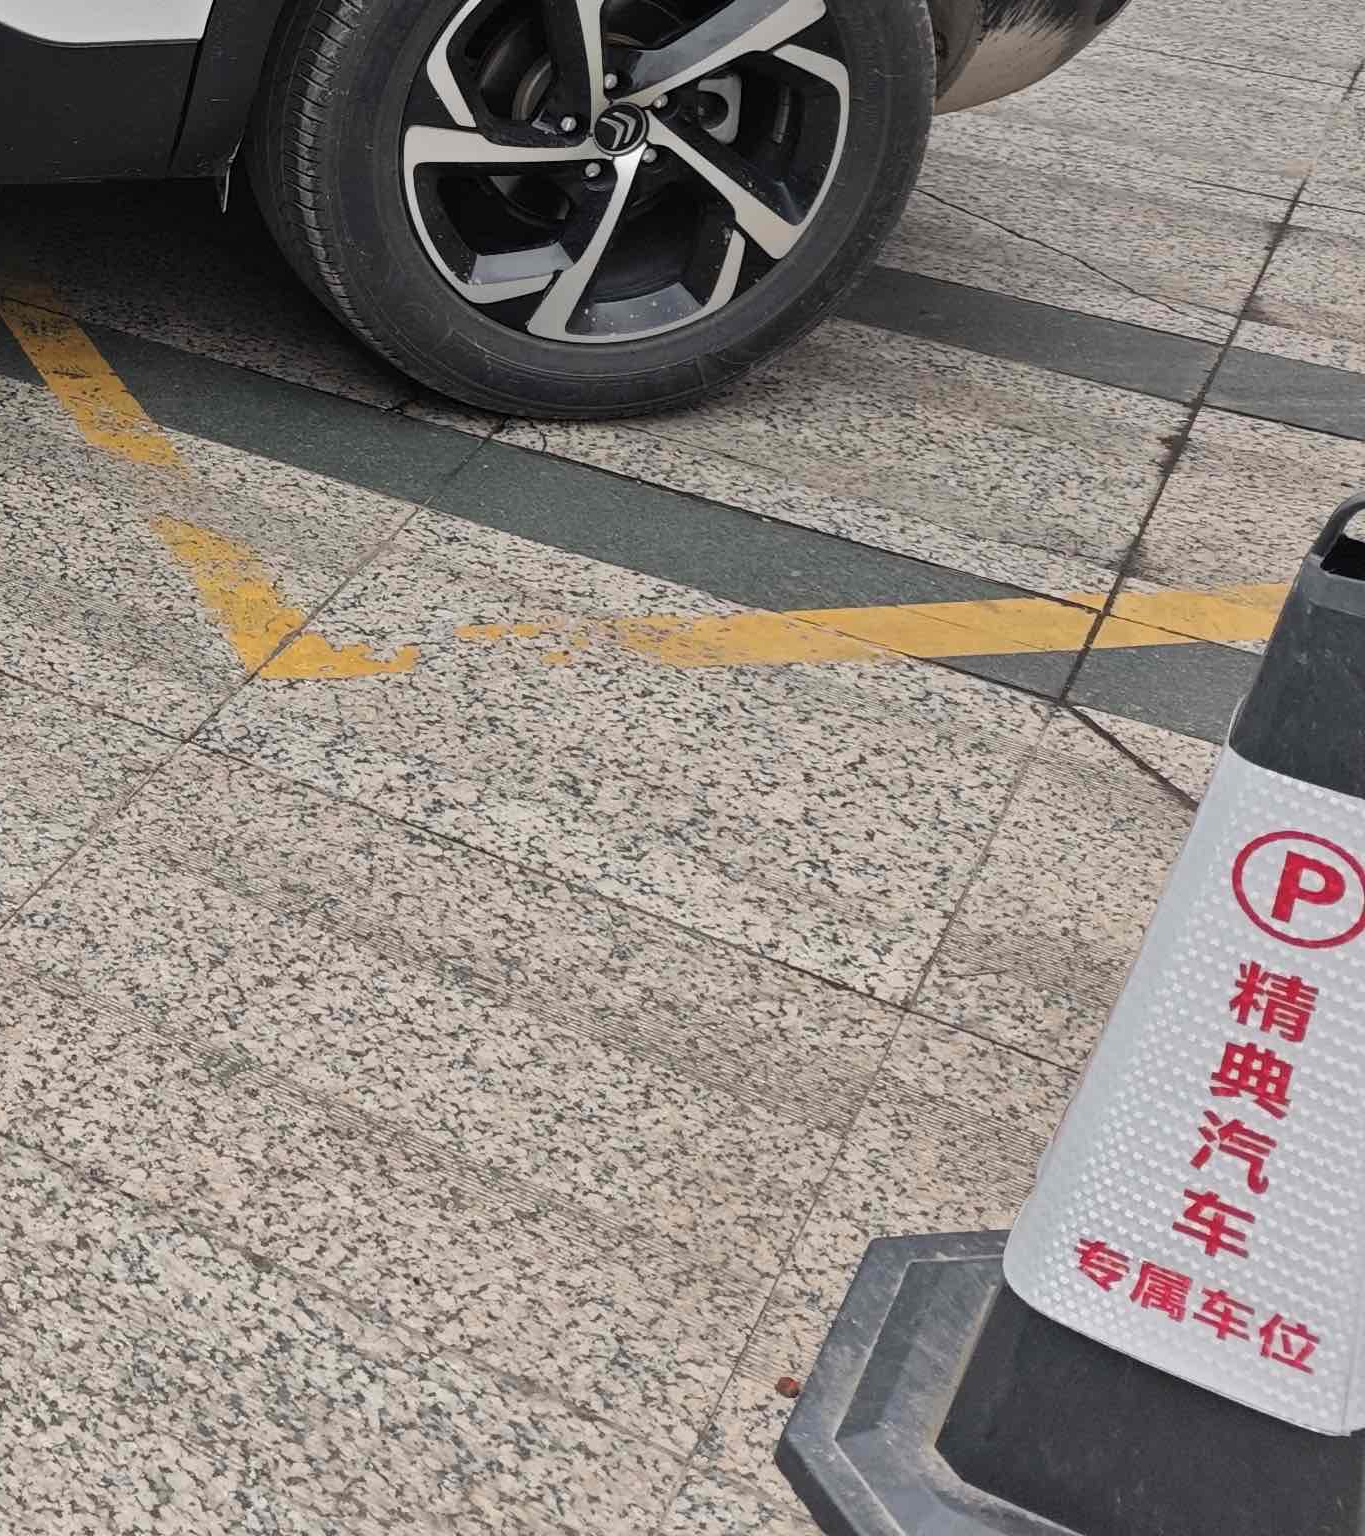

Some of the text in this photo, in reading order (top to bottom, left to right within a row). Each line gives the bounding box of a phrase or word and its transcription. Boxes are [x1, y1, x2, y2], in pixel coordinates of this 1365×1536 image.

[1271, 850, 1347, 925] P
[1172, 959, 1319, 1259] 精典汽车
[1074, 1238, 1320, 1375] 专属车位
